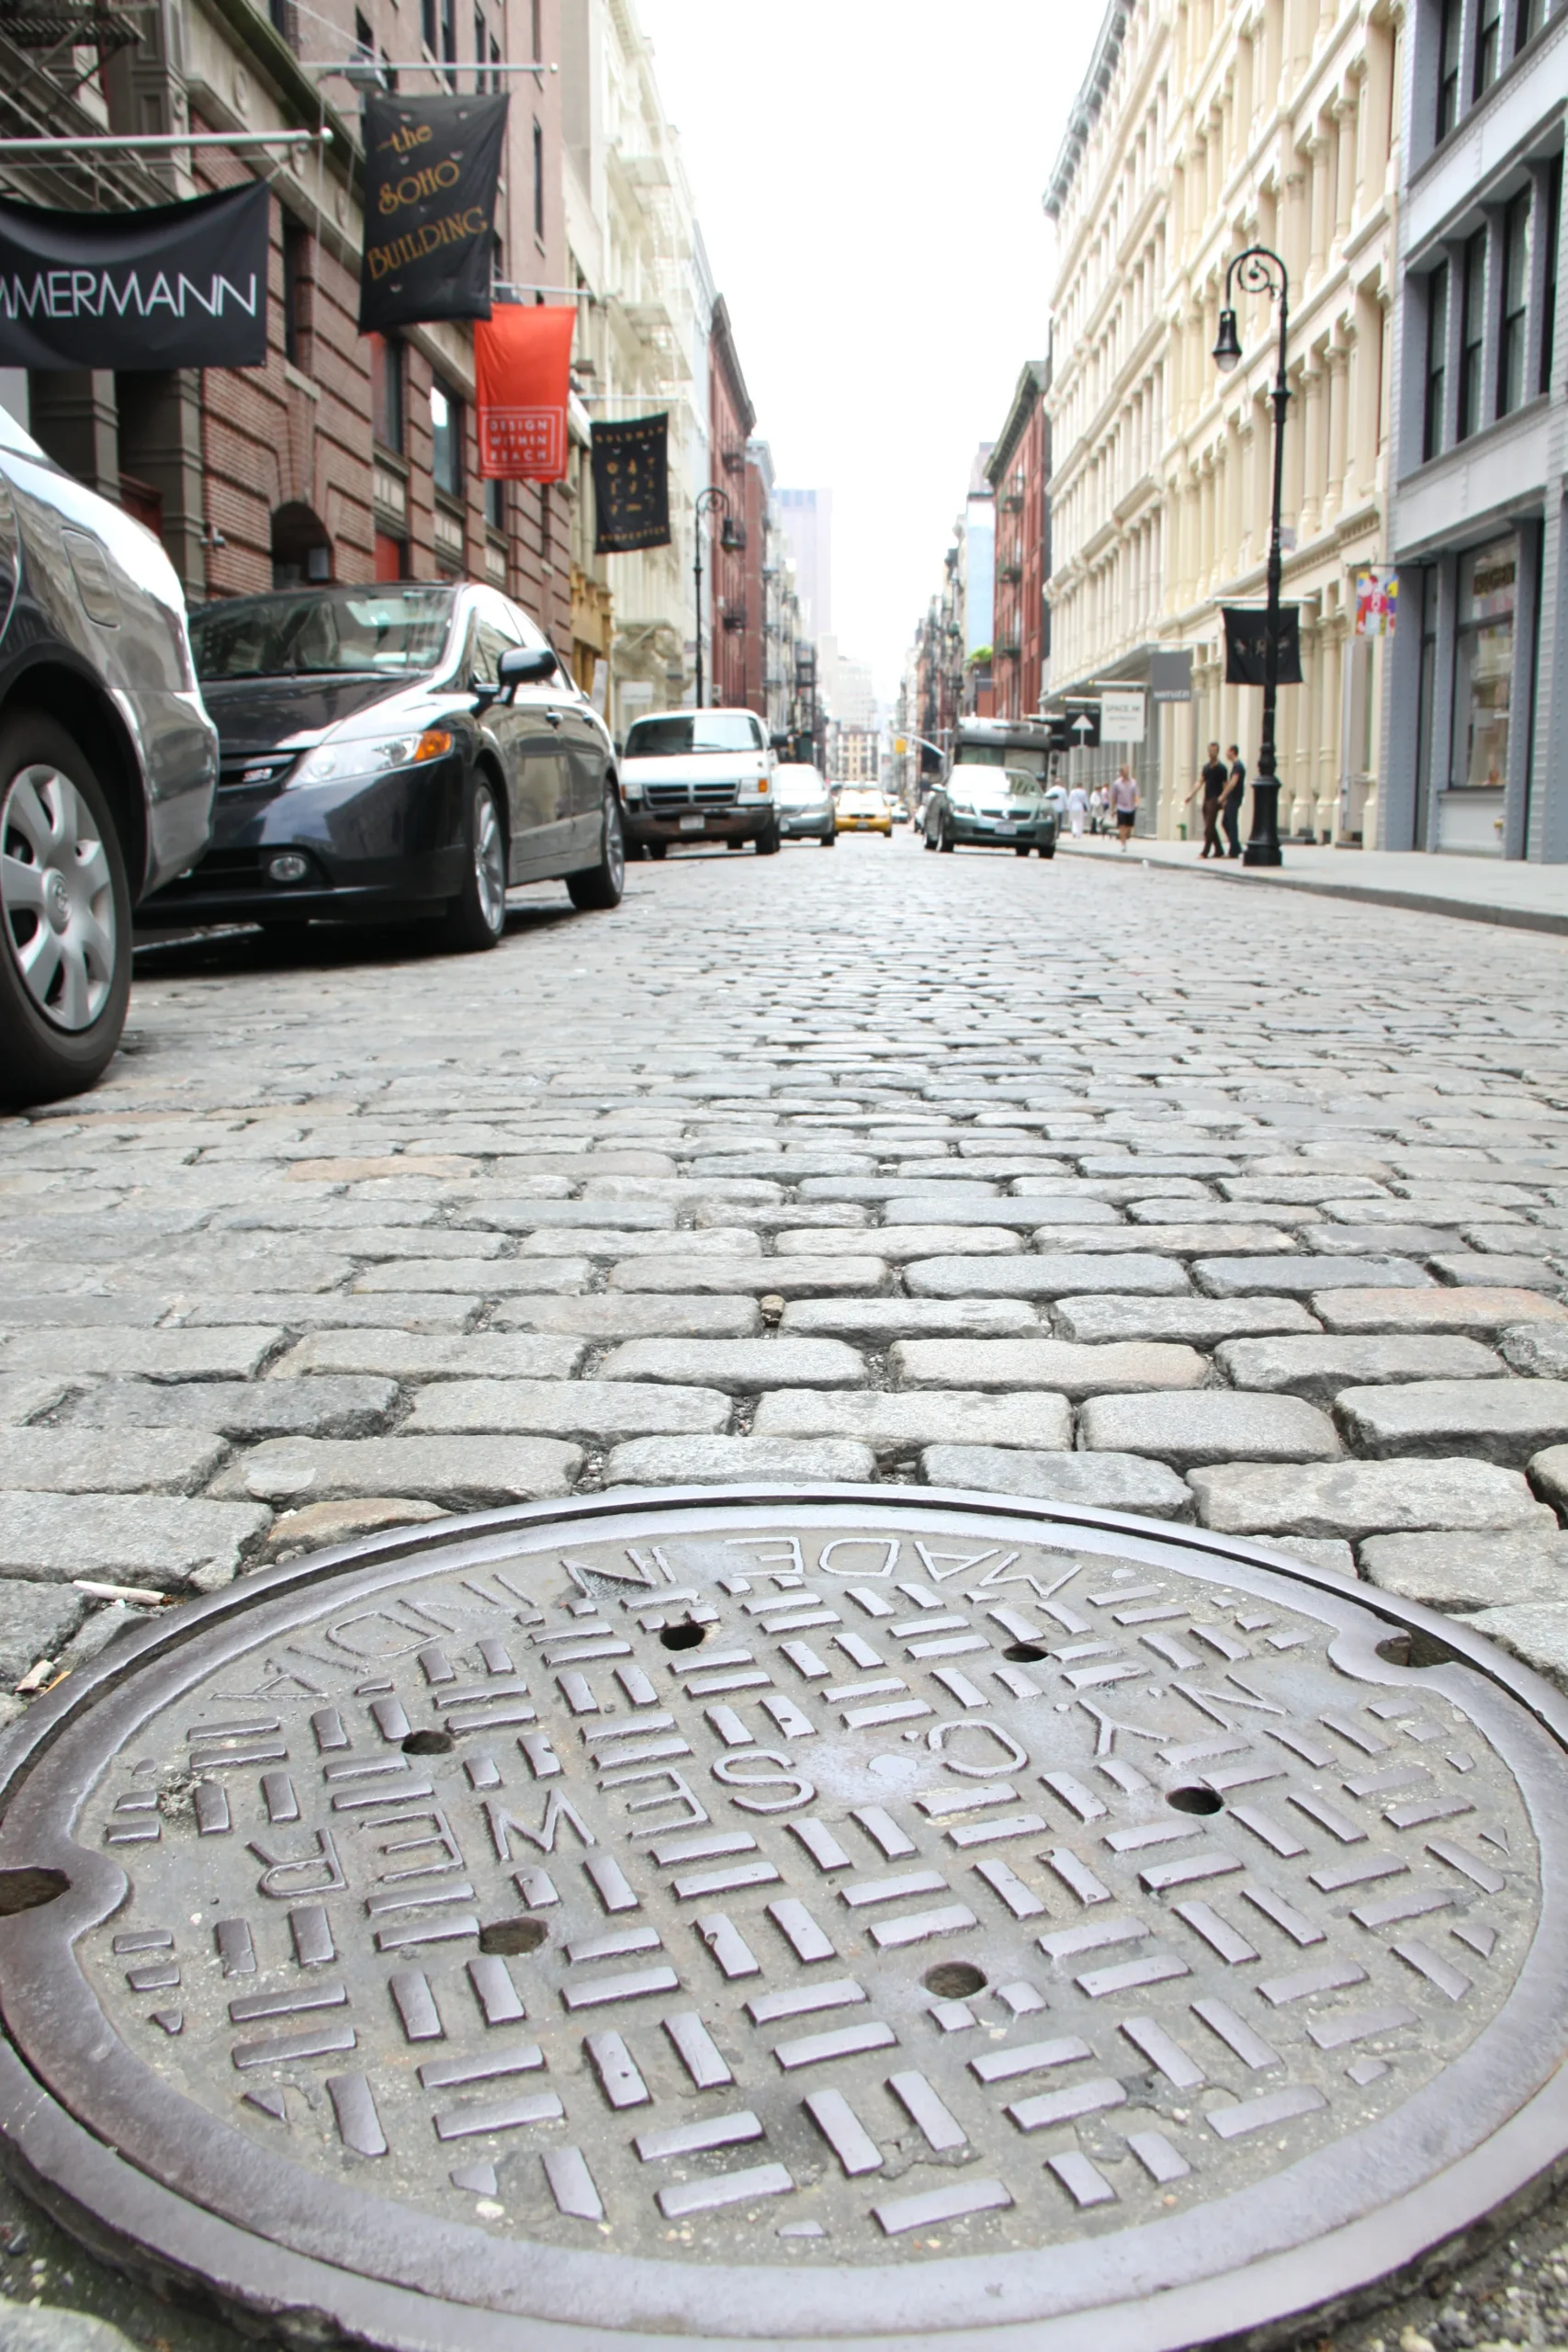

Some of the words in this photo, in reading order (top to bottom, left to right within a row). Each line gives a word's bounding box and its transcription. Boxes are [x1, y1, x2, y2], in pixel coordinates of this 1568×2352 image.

[378, 125, 432, 153] the
[378, 160, 459, 215] SOHO
[367, 207, 488, 280] BUILDING
[561, 1545, 676, 1599] IN
[723, 1536, 1082, 1598] MADE
[212, 1572, 538, 1699] INDIA
[246, 1749, 817, 1898] SEWER
